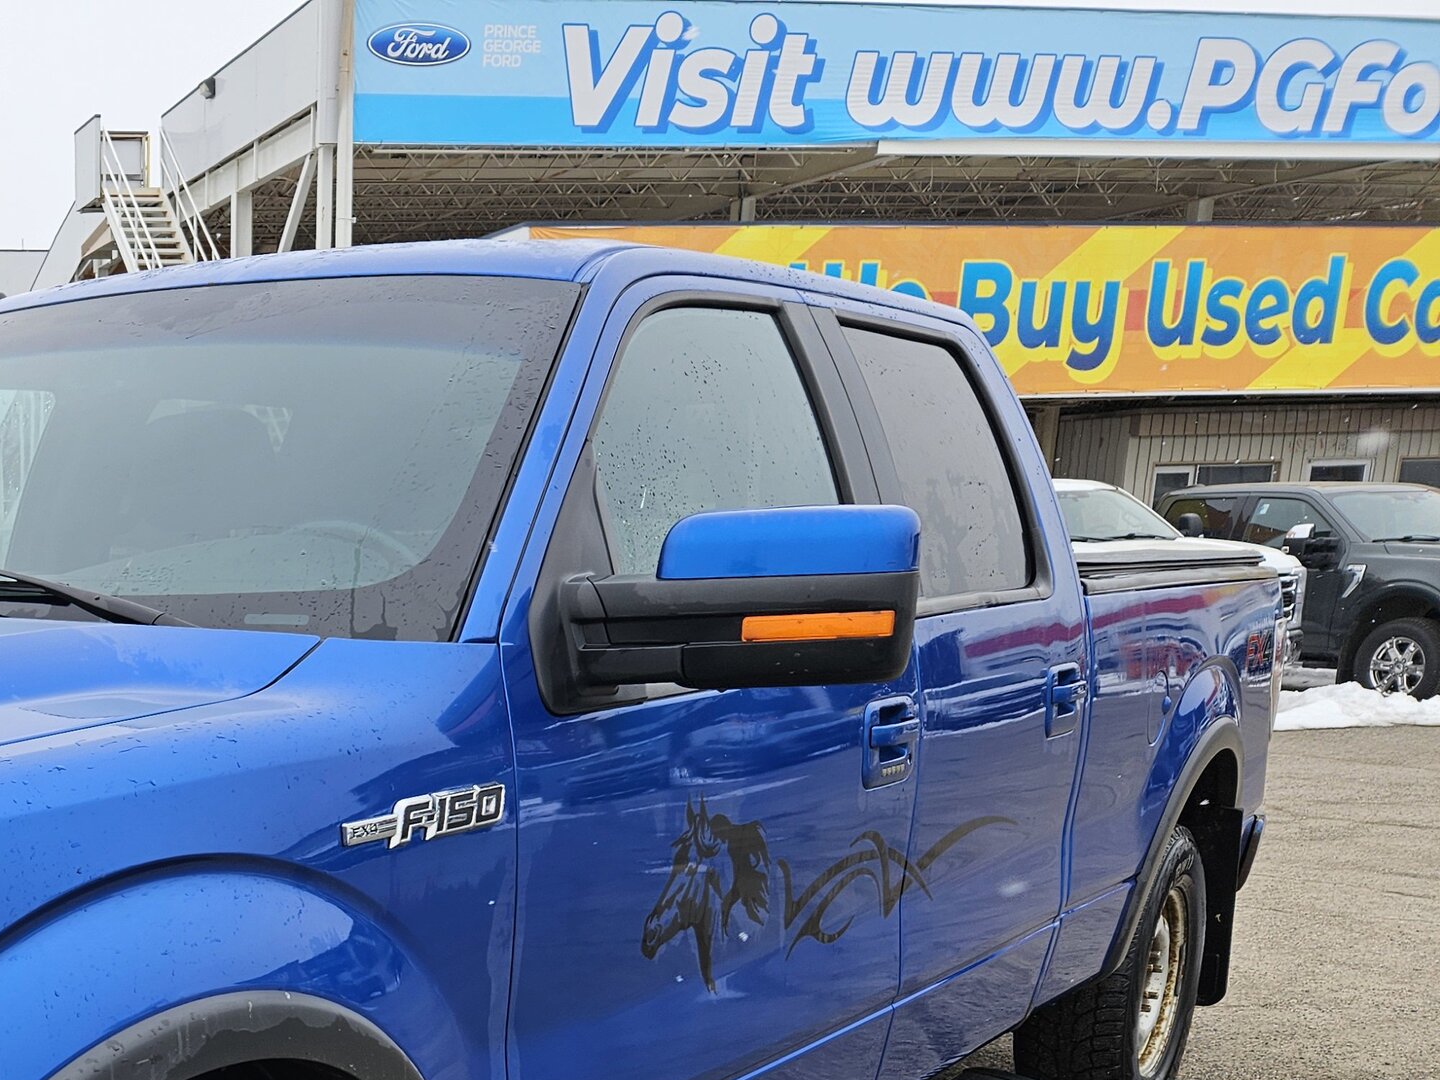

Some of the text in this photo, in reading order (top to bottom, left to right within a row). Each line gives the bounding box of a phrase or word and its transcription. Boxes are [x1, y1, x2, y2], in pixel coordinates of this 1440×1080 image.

[376, 27, 452, 60] Ford
[483, 24, 537, 39] PRINCE
[482, 40, 542, 53] GEORGE
[482, 55, 522, 68] FORD
[562, 11, 817, 128] Visit
[956, 261, 1122, 372] Buy
[1146, 255, 1348, 348] Used
